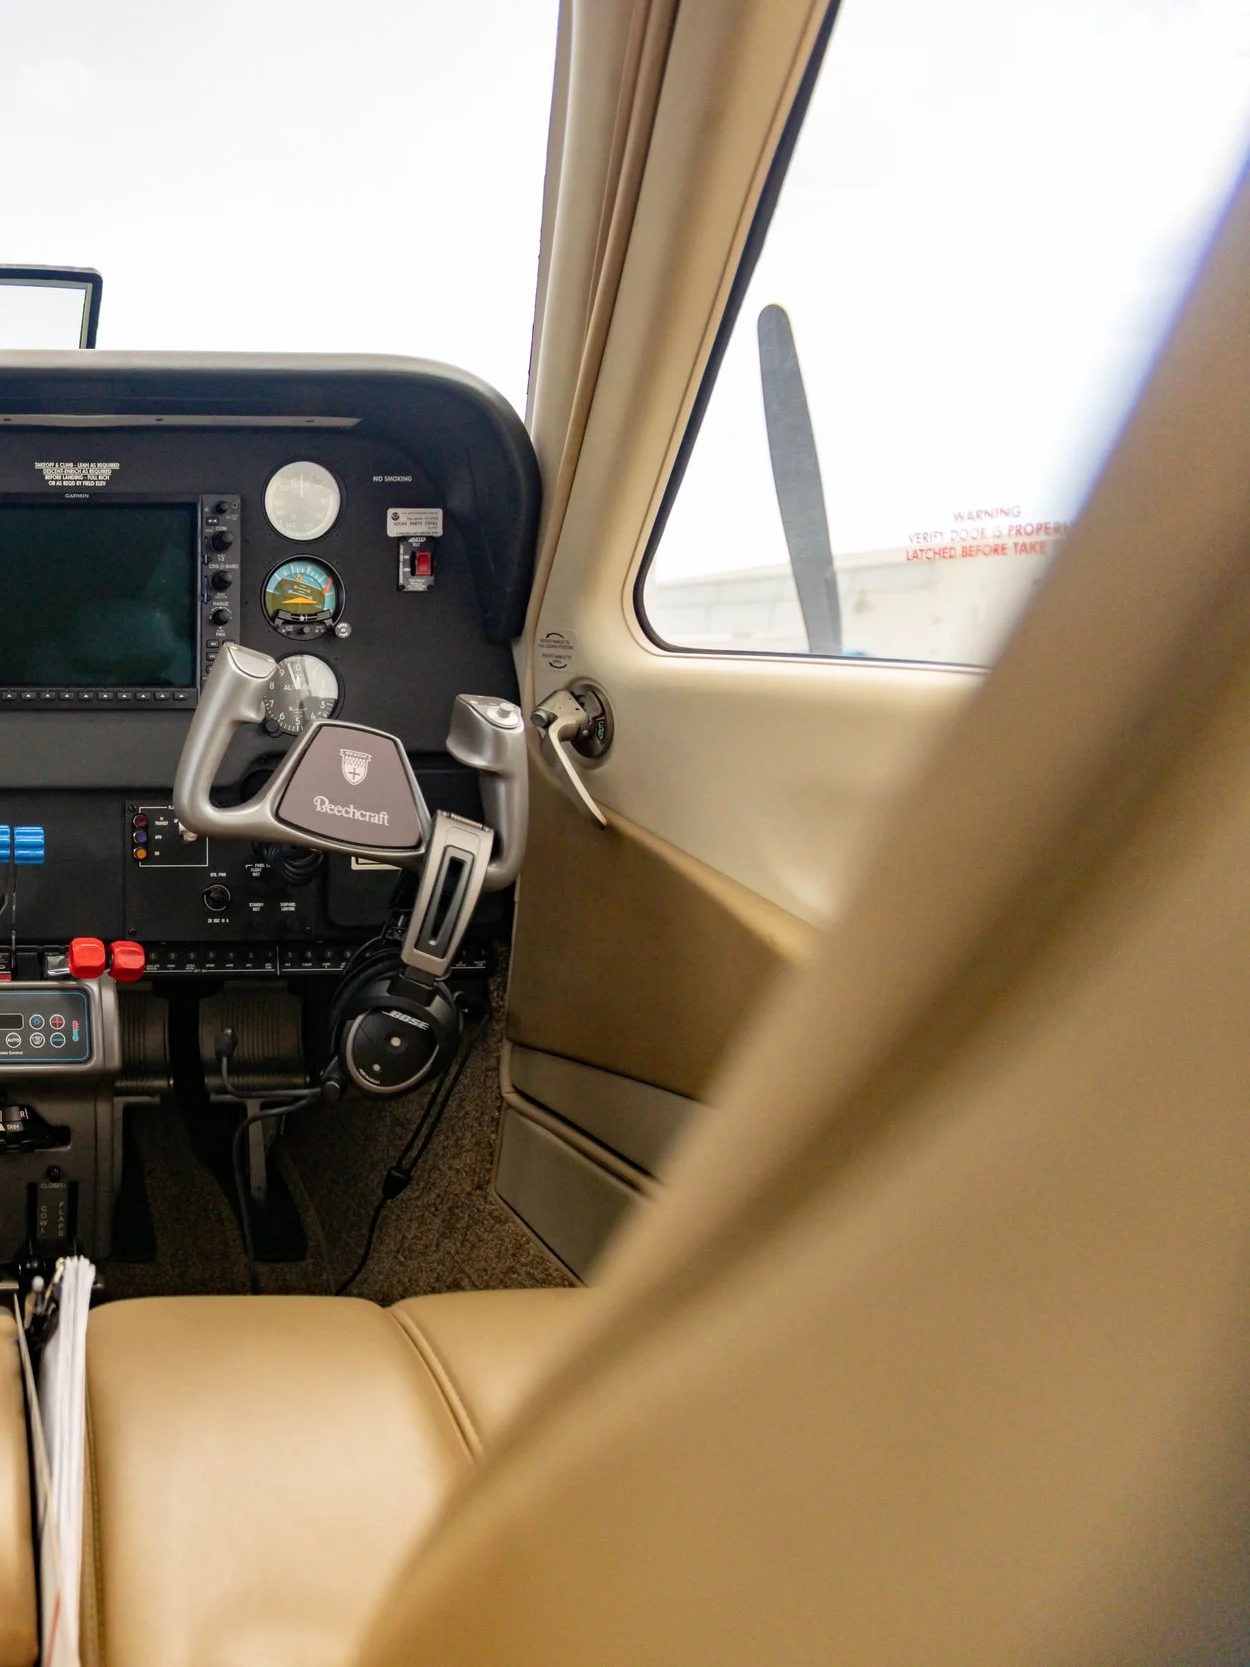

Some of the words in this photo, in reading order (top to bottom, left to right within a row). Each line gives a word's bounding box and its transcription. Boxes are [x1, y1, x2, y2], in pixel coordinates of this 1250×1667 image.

[953, 505, 1022, 522] WARNING
[908, 531, 944, 544] VERIFY
[906, 547, 956, 561] LATCHED
[962, 543, 1008, 558] BEFORE
[1013, 541, 1048, 556] TAKE
[279, 669, 285, 677] 9
[319, 701, 325, 709] 3
[279, 712, 285, 720] 6
[345, 750, 367, 758] BEECH
[313, 795, 390, 826] Beechcraft
[384, 1010, 430, 1031] BOSE
